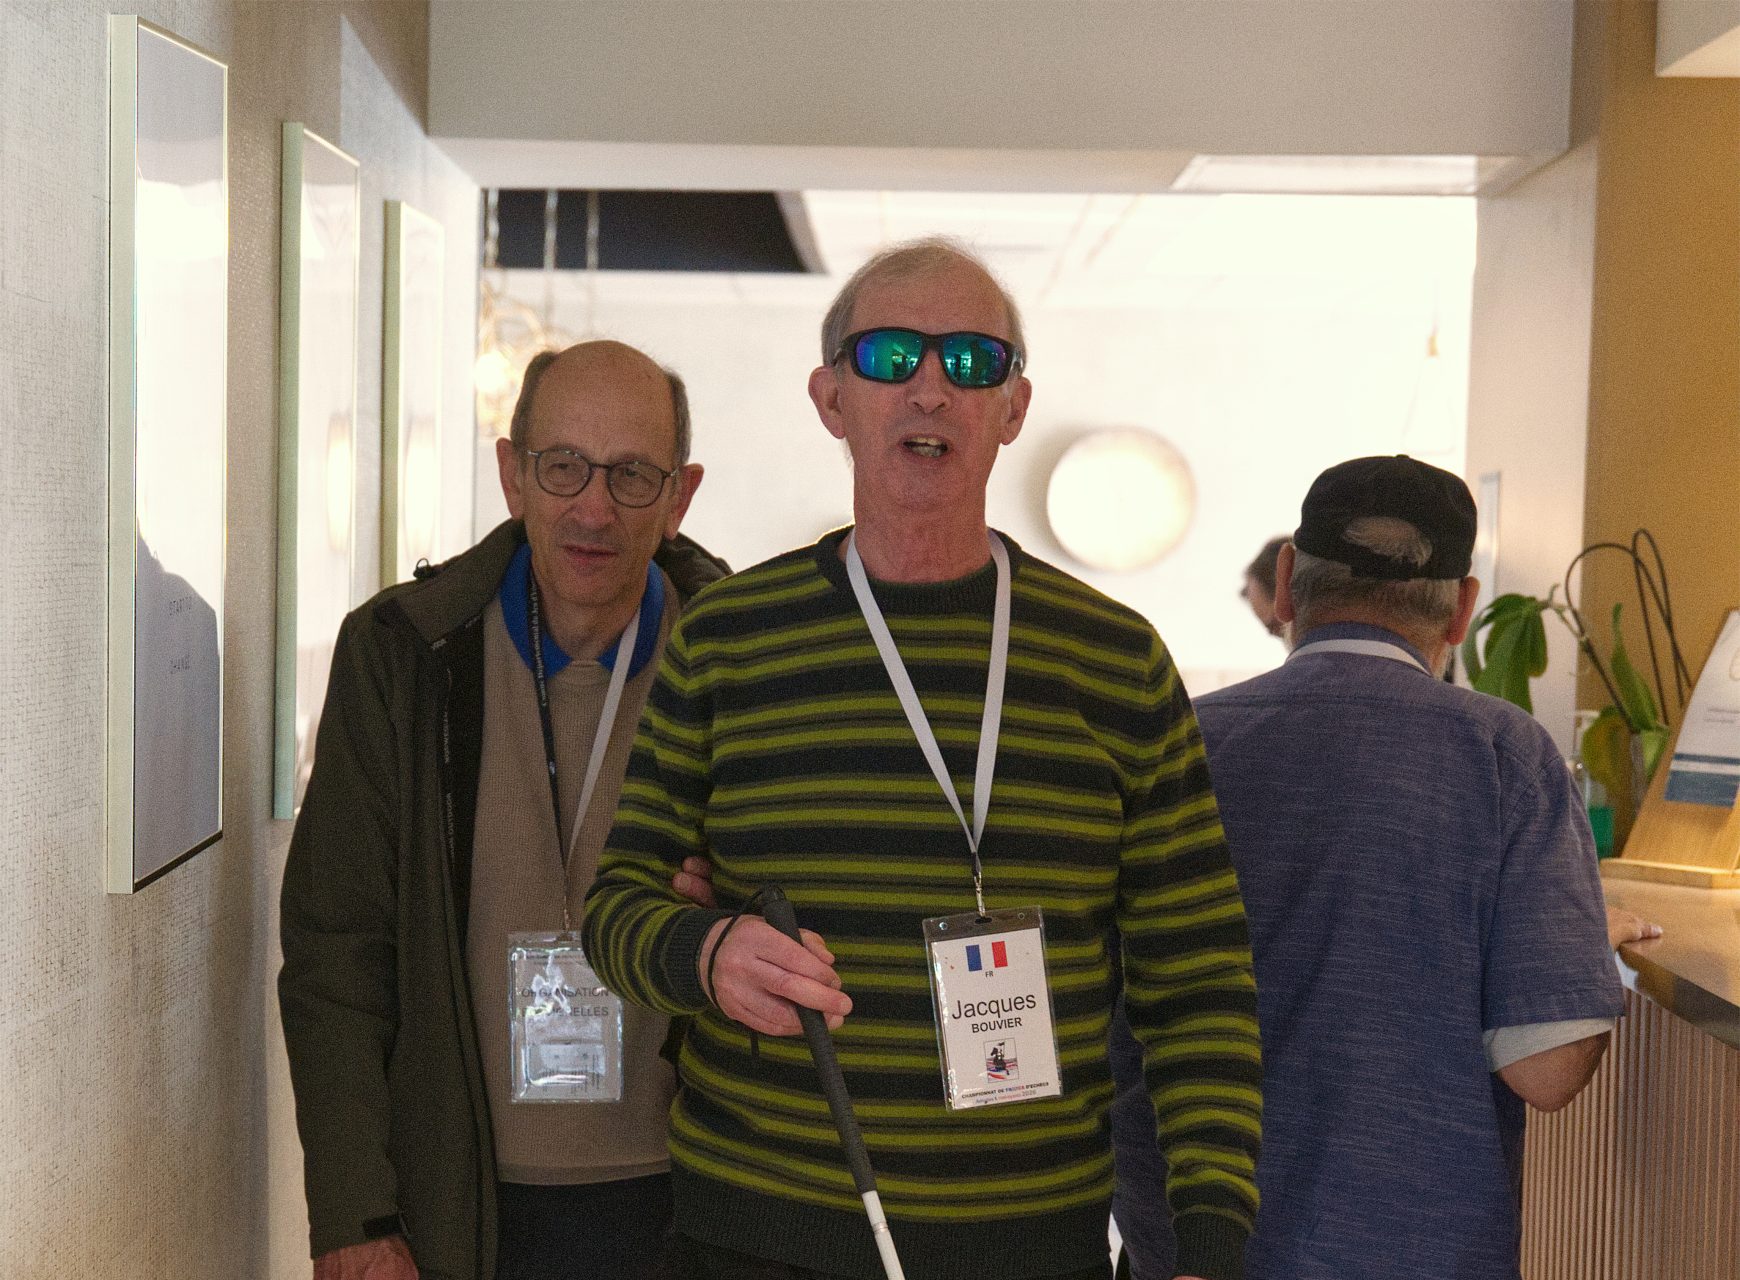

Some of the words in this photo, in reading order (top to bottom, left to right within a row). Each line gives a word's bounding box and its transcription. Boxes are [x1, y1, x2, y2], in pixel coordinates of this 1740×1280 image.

[985, 970, 994, 978] FR
[952, 994, 1036, 1020] Jacques
[971, 1017, 1023, 1033] BOUVIER
[961, 1089, 997, 1099] CHAMPIONNAT
